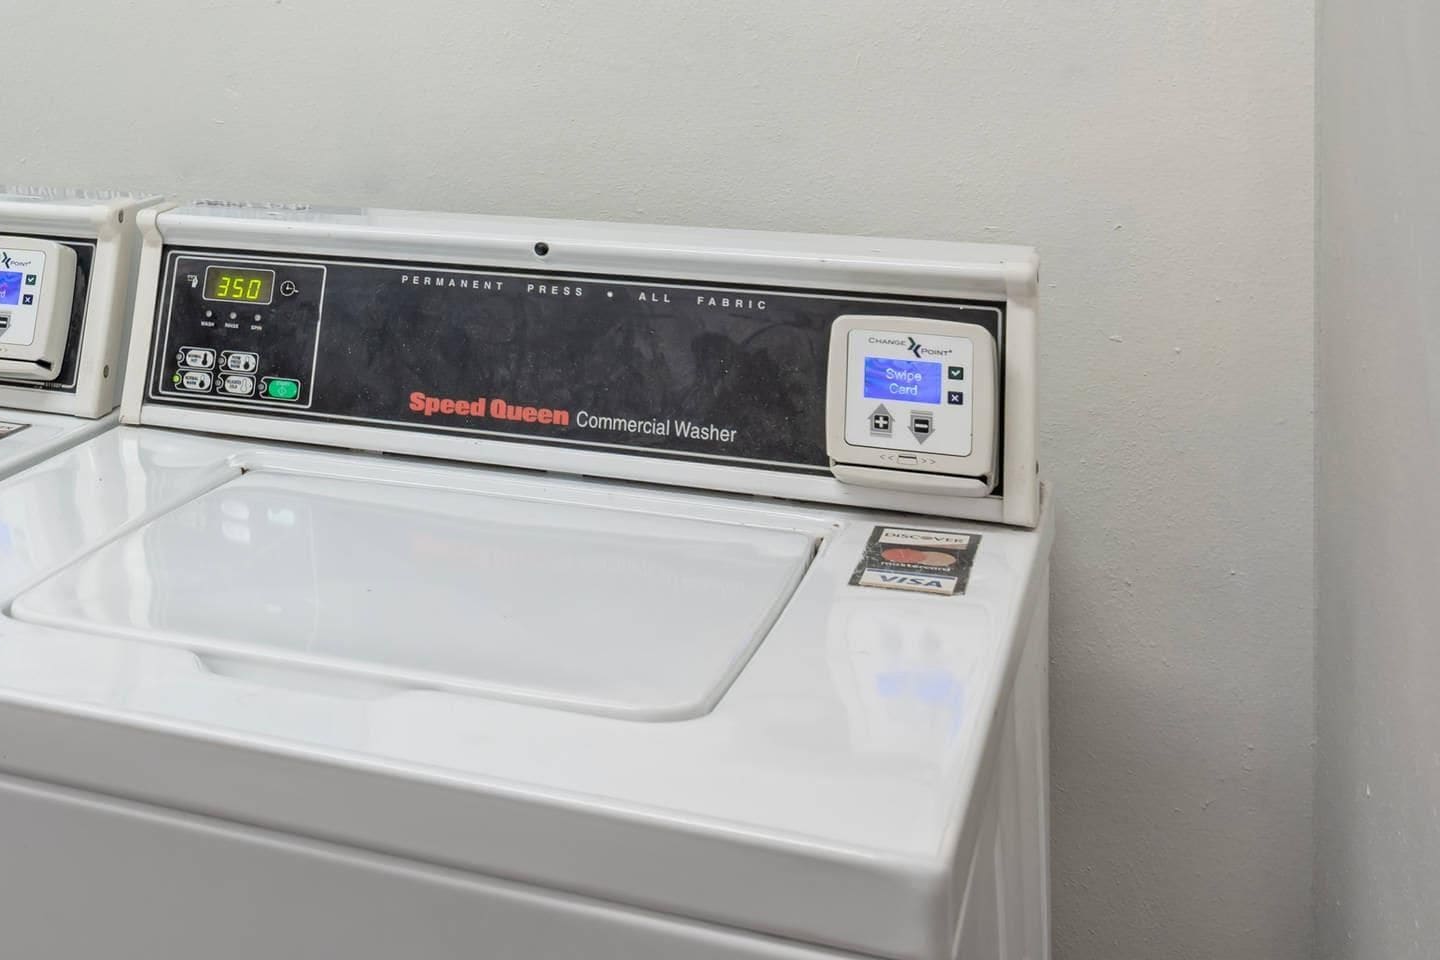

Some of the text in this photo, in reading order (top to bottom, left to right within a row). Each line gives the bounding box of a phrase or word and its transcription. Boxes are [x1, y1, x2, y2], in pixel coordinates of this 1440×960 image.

[217, 276, 262, 300] 350
[401, 274, 768, 311] PERMANENT PRESS ALL FABRIC
[868, 336, 907, 346] CHANGE
[885, 367, 922, 383] Swipe
[889, 383, 918, 396] Card
[409, 391, 737, 443] Speed Queen Commercial Washer
[884, 531, 964, 544] DISCOVER
[880, 574, 943, 589] VISA
